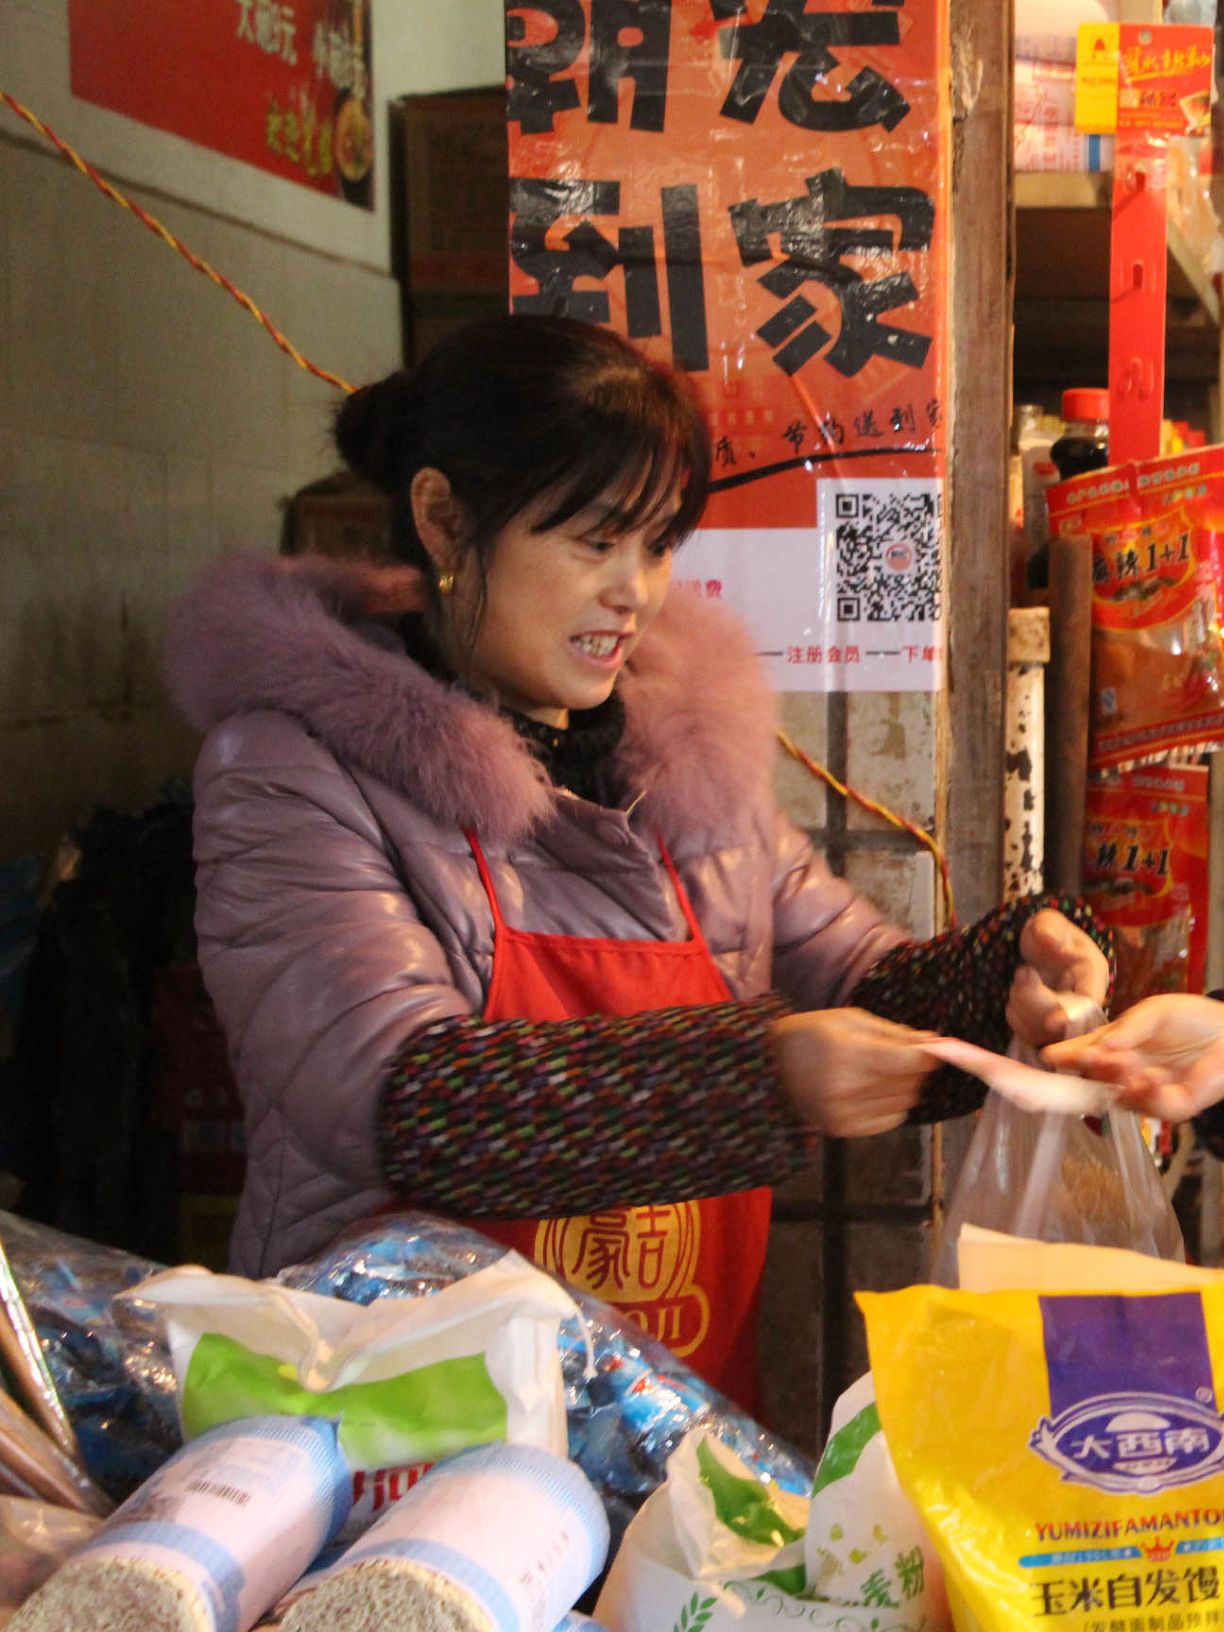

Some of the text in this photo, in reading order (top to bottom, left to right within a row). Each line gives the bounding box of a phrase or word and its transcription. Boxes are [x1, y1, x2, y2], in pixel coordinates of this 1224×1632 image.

[508, 167, 936, 377] 到家
[787, 645, 861, 664] 注册会员
[624, 1305, 682, 1341] OJI
[1070, 1427, 1210, 1459] 大西南
